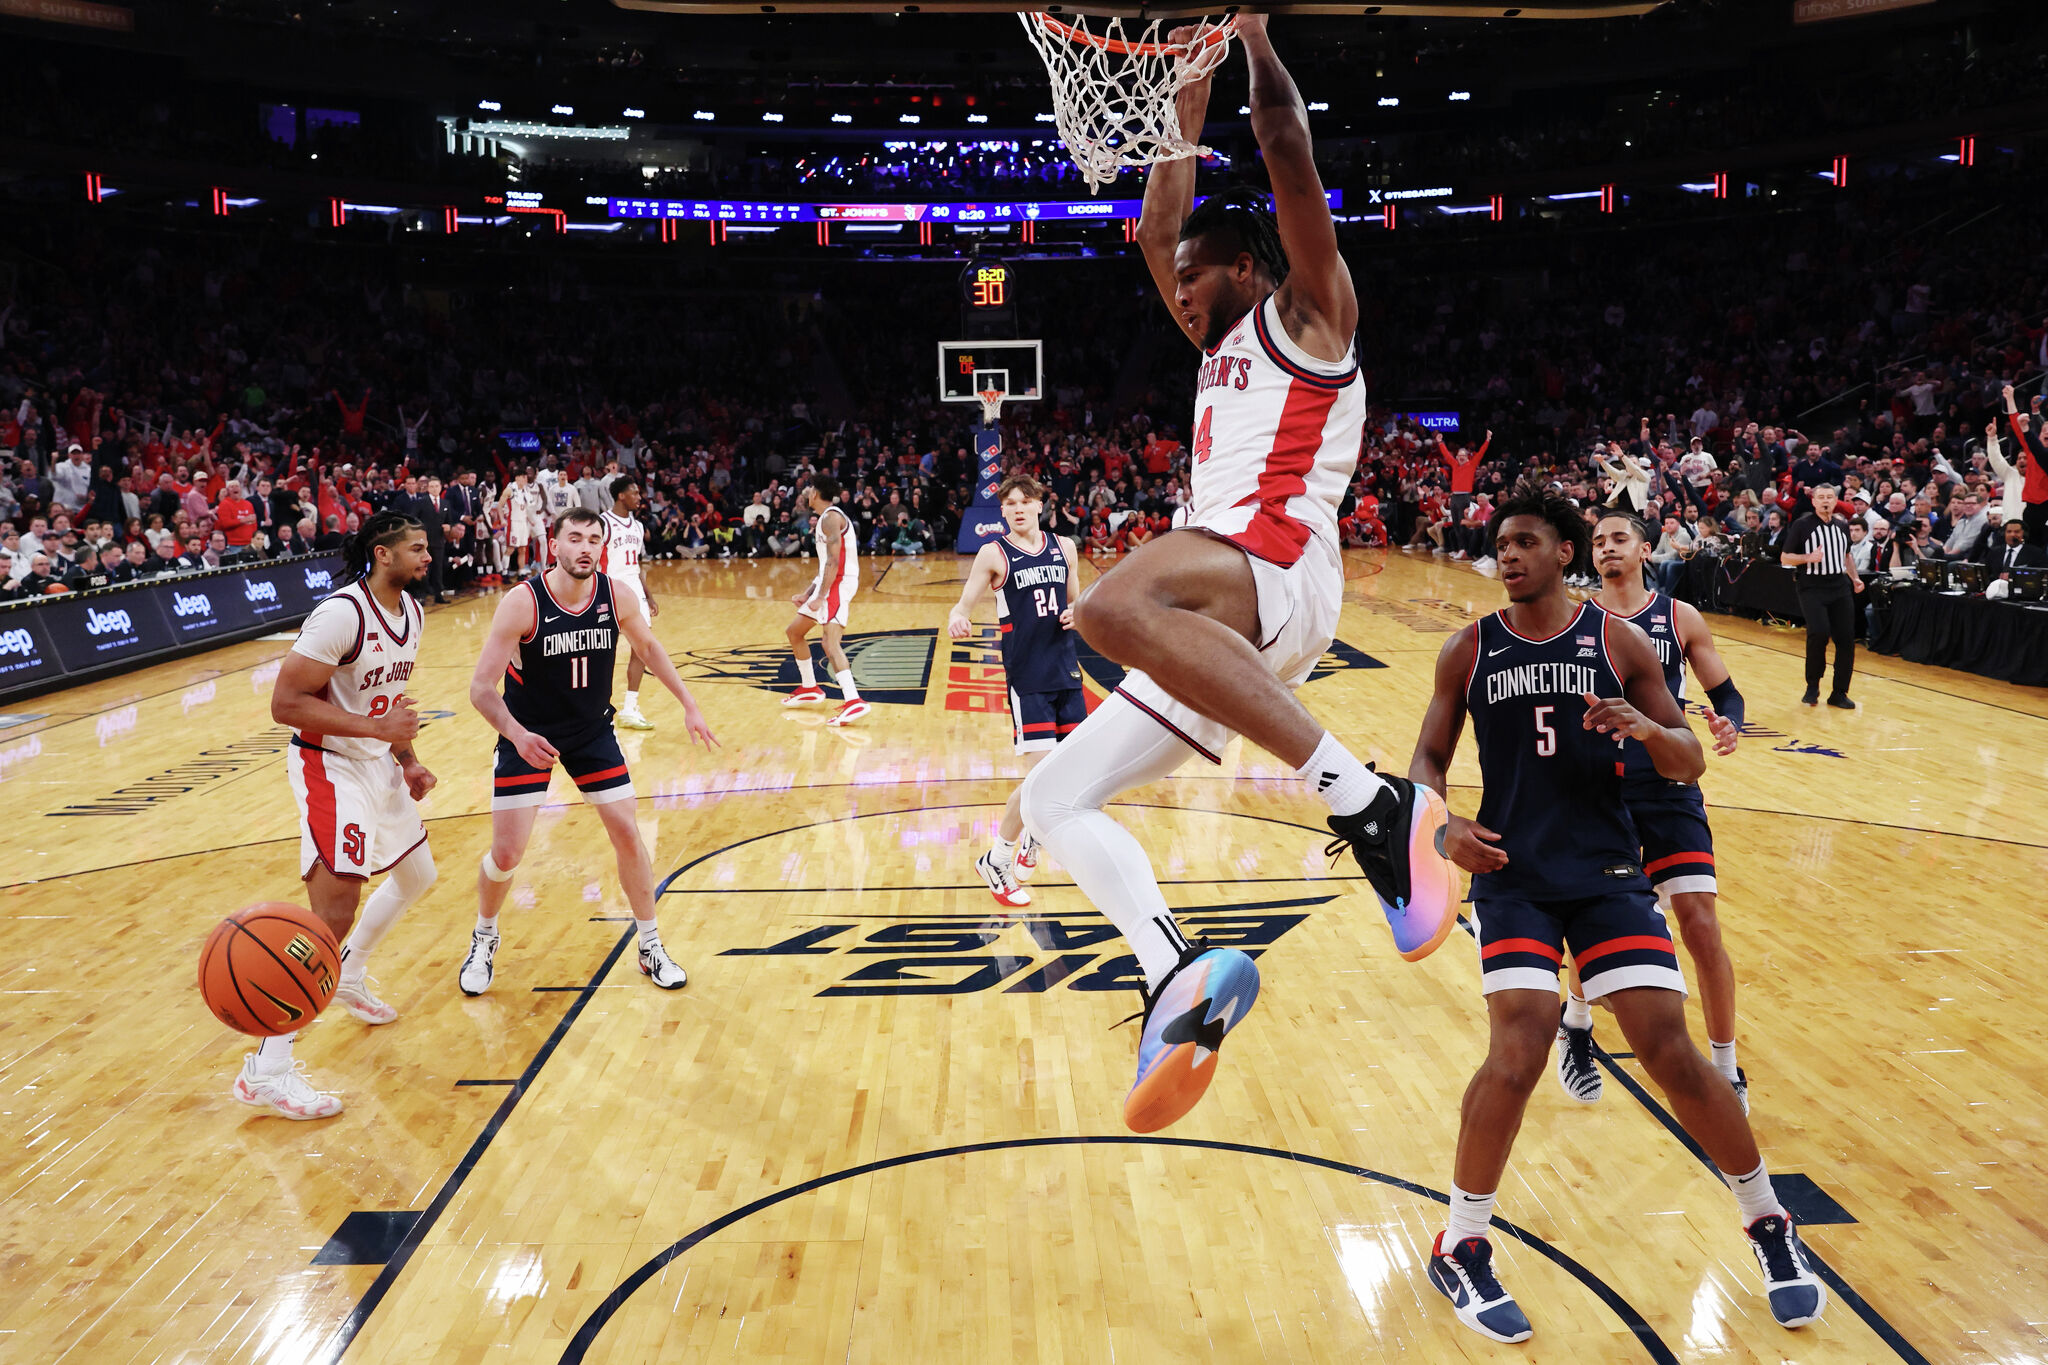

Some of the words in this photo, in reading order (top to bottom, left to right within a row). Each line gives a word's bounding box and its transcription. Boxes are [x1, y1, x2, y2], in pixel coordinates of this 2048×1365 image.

[506, 191, 543, 200] TOLEDO
[1384, 188, 1452, 200] @THEGARDEN
[820, 208, 838, 217] ST.
[841, 207, 888, 217] JOHN'S
[932, 206, 949, 217] 30
[958, 209, 985, 220] 8:20
[994, 206, 1011, 217] 16
[1067, 204, 1113, 215] UCONN
[977, 268, 1005, 282] 8:20
[972, 282, 1003, 305] 30
[1422, 417, 1459, 427] ULTRA
[1192, 405, 1212, 464] 4
[975, 521, 1005, 536] Crush
[625, 550, 637, 566] 11
[304, 568, 333, 589] Jeep
[1014, 564, 1067, 590] CONNECTICUT
[245, 579, 277, 602] Jeep
[1033, 586, 1059, 617] 24
[173, 592, 211, 616] Jeep
[86, 607, 132, 635] Jeep
[0, 628, 34, 656] eep
[543, 628, 612, 657] CONNECTICUT
[359, 666, 384, 691] ST.
[571, 656, 588, 689] 11
[1487, 662, 1597, 704] CONNECTICUT
[368, 693, 405, 717] 2
[1535, 705, 1556, 757] 5
[714, 914, 1310, 956] EAST
